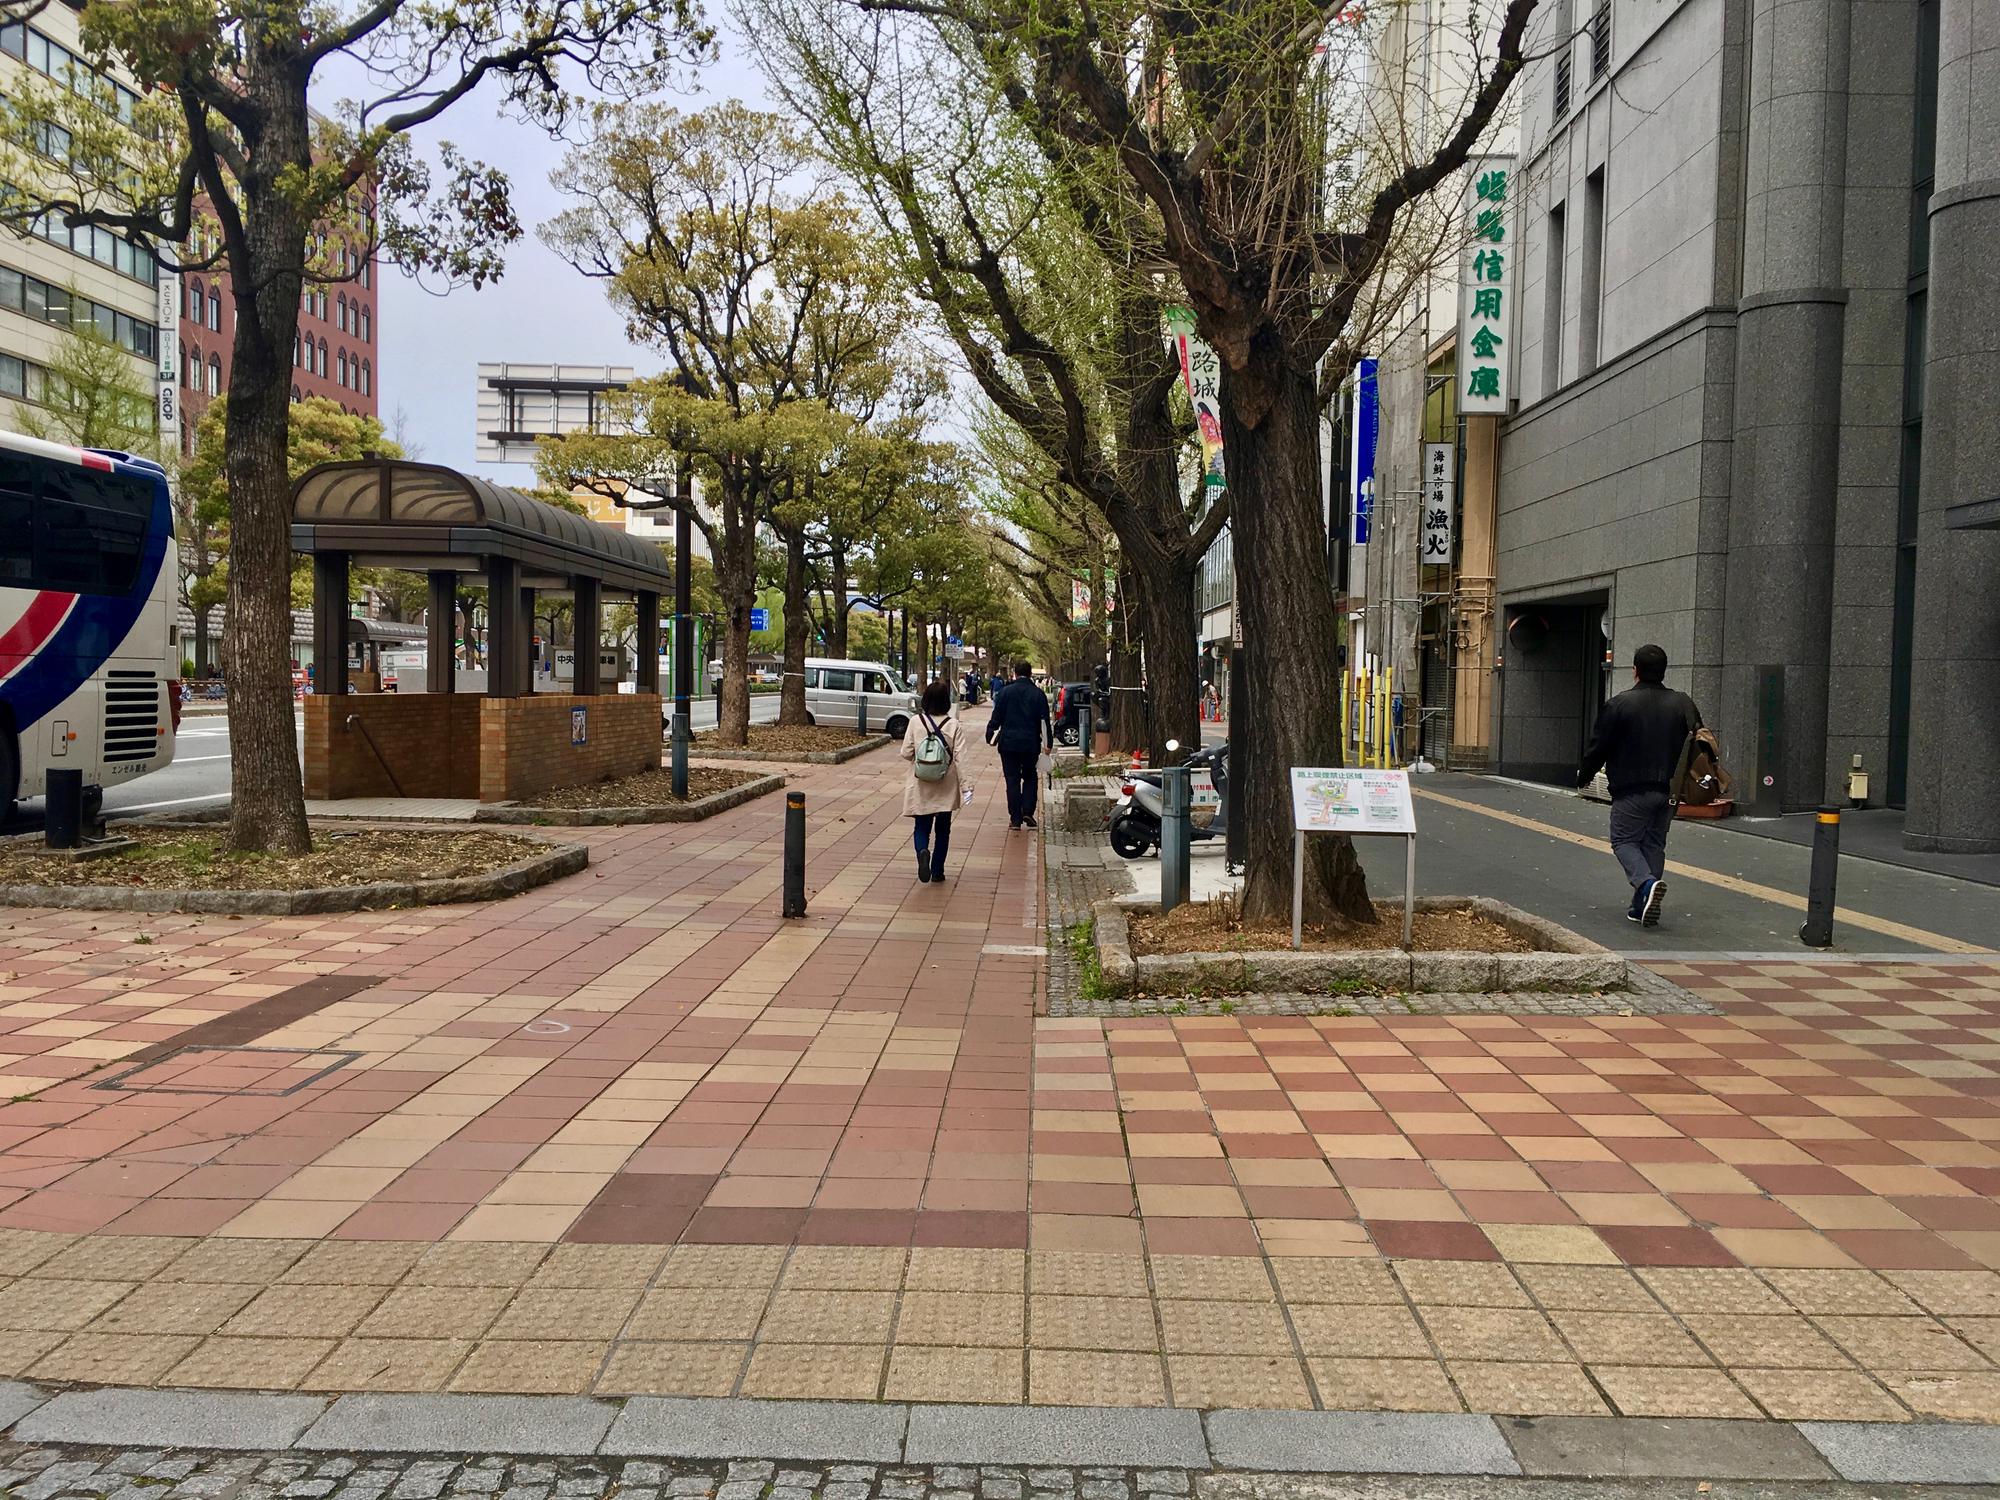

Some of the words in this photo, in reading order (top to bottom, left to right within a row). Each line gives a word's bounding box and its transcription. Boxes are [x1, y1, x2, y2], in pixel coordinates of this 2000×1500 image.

[163, 285, 172, 323] KUMON
[1467, 170, 1507, 400] 姫路信用金庫
[162, 388, 173, 420] GROP
[1432, 450, 1445, 503] 海鮮市場
[1424, 508, 1449, 555] 漁火
